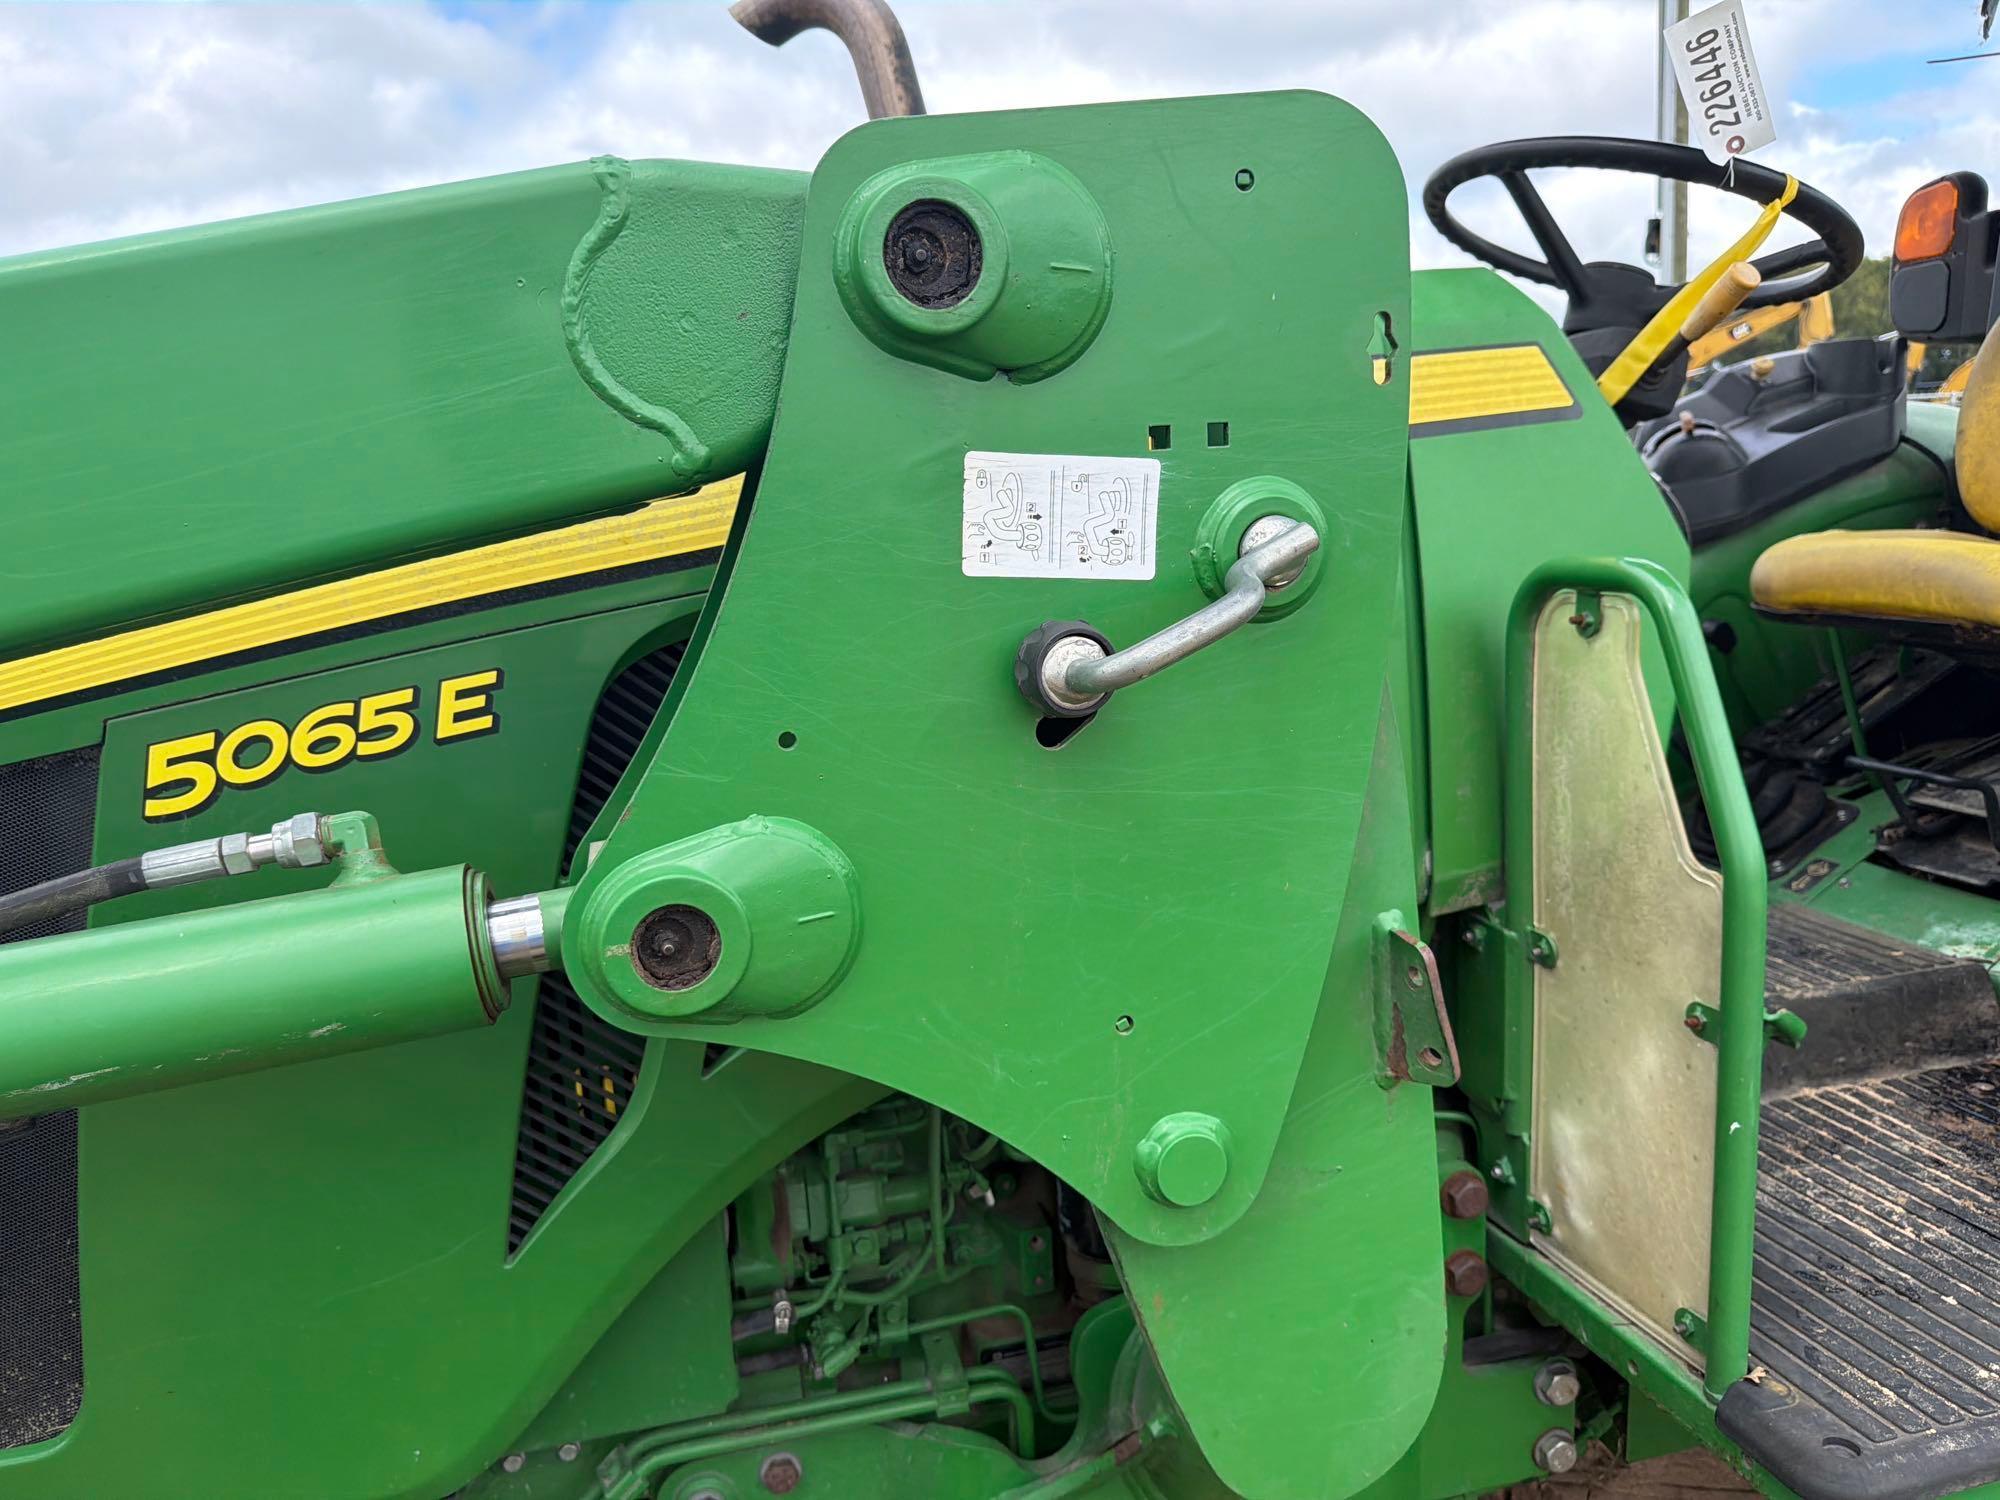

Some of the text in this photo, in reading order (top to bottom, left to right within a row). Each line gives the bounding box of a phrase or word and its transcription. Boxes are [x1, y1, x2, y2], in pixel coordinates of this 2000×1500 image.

[1685, 28, 1742, 136] 226446
[1723, 24, 1753, 118] REBEL AUCTION COMPANY
